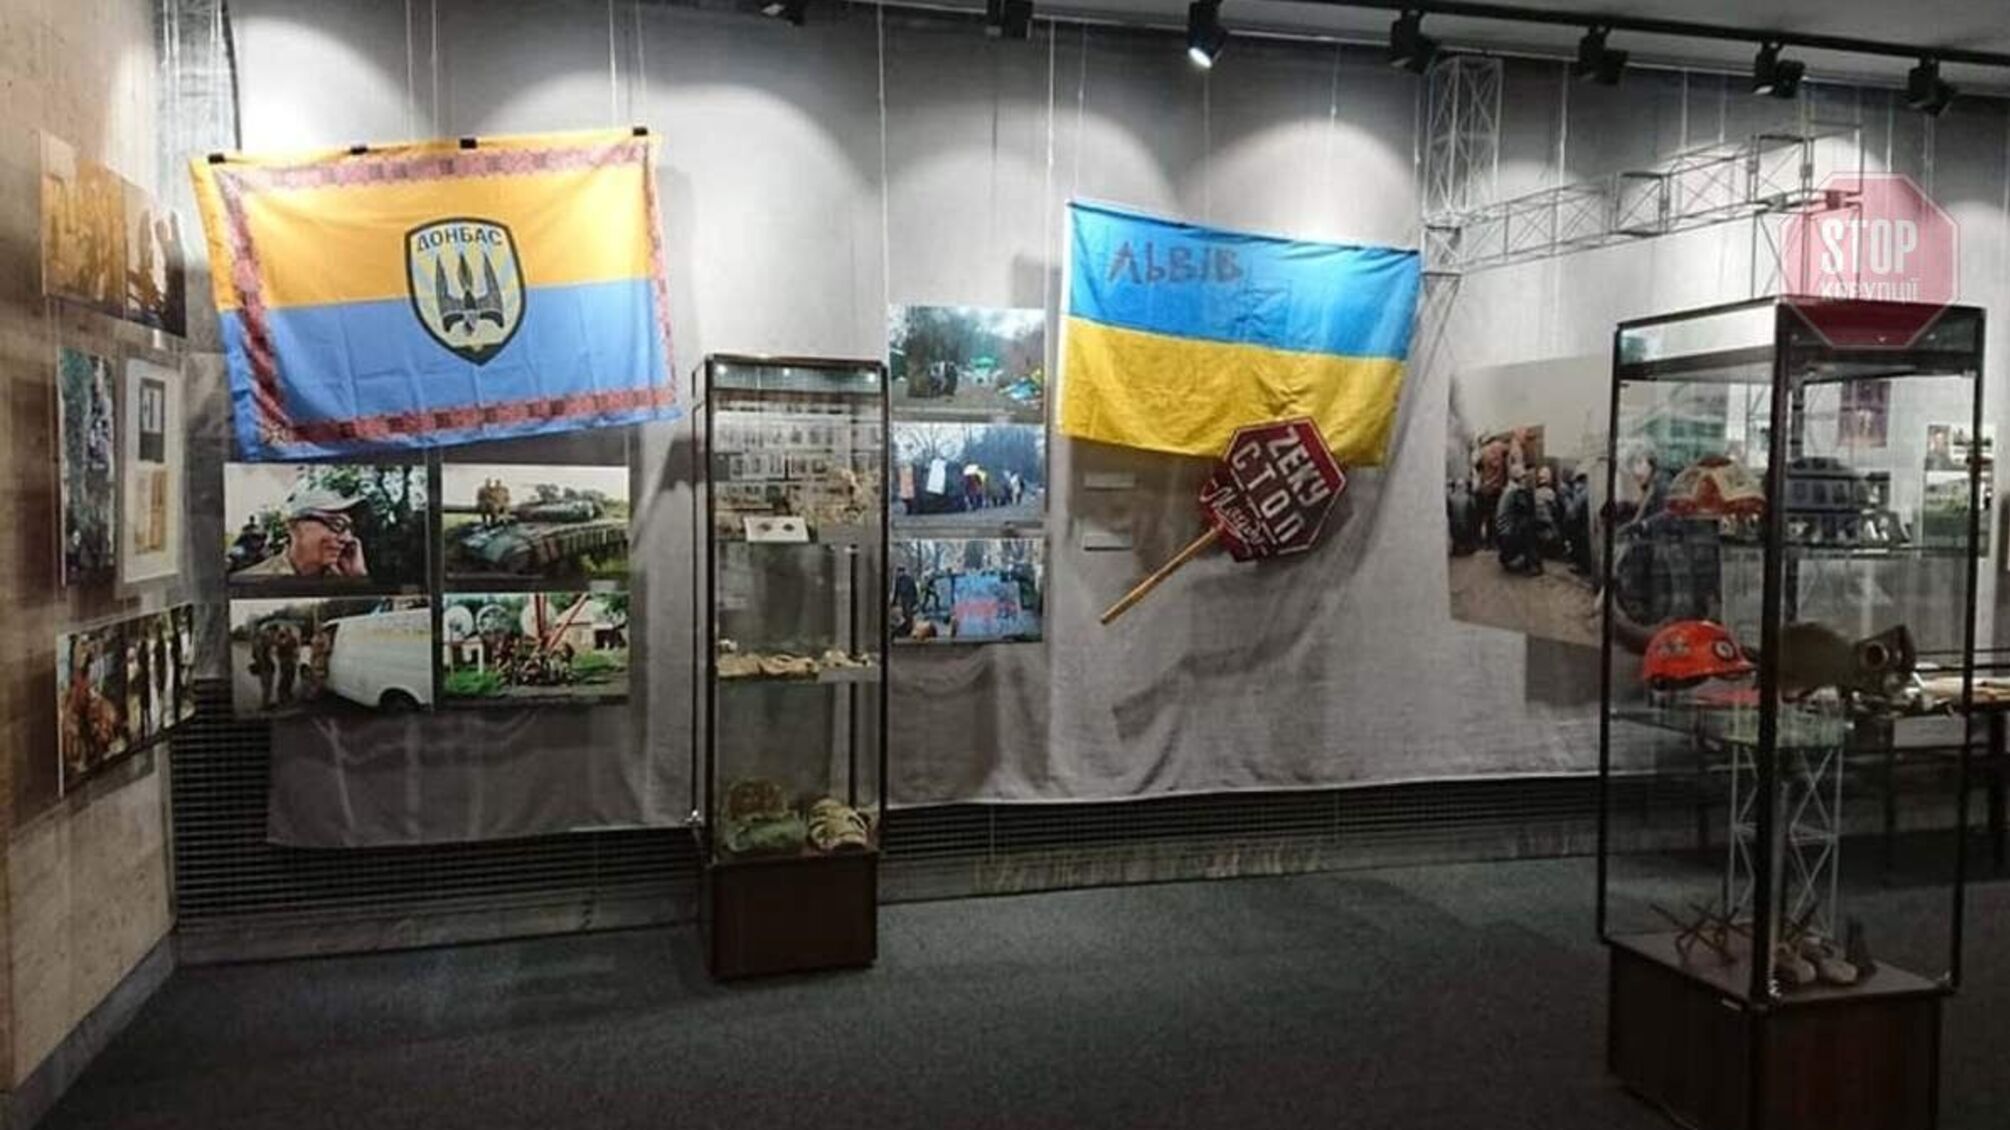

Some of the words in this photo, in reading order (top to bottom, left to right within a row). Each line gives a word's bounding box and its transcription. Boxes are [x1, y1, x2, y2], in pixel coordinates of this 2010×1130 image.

[416, 225, 502, 252] ДОНБАС
[1108, 241, 1244, 285] ЛЬВІВ
[1231, 441, 1304, 543] СТОП
